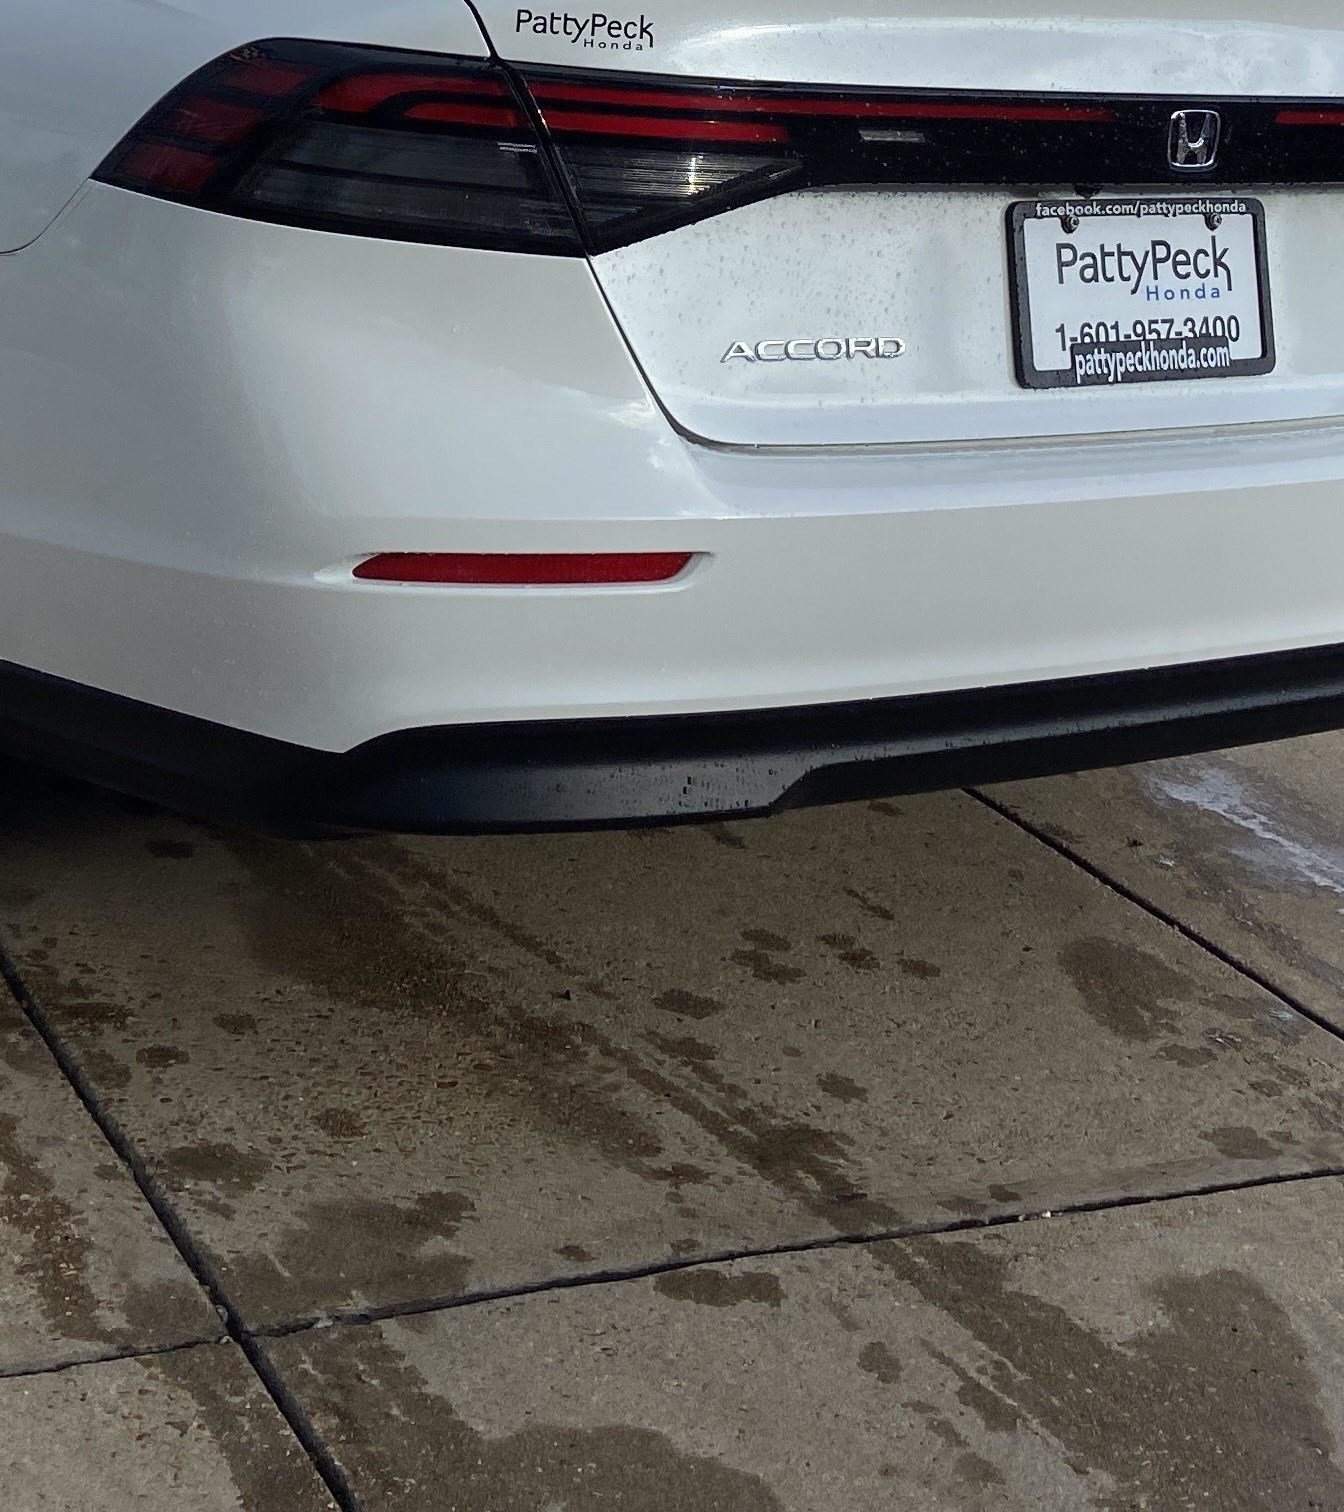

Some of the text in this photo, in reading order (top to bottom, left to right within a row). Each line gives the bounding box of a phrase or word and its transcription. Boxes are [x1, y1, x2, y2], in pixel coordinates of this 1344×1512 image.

[515, 9, 654, 48] PattyPeck
[584, 38, 644, 51] Honda
[1036, 200, 1247, 217] facebook.com/pattypeckhonda
[1055, 235, 1232, 295] PattyPeck
[1146, 283, 1221, 302] Honda
[721, 335, 907, 363] ACCORD
[1055, 315, 1240, 351] 1-601-957-3400
[1074, 340, 1231, 384] pattypeckhonda.com
